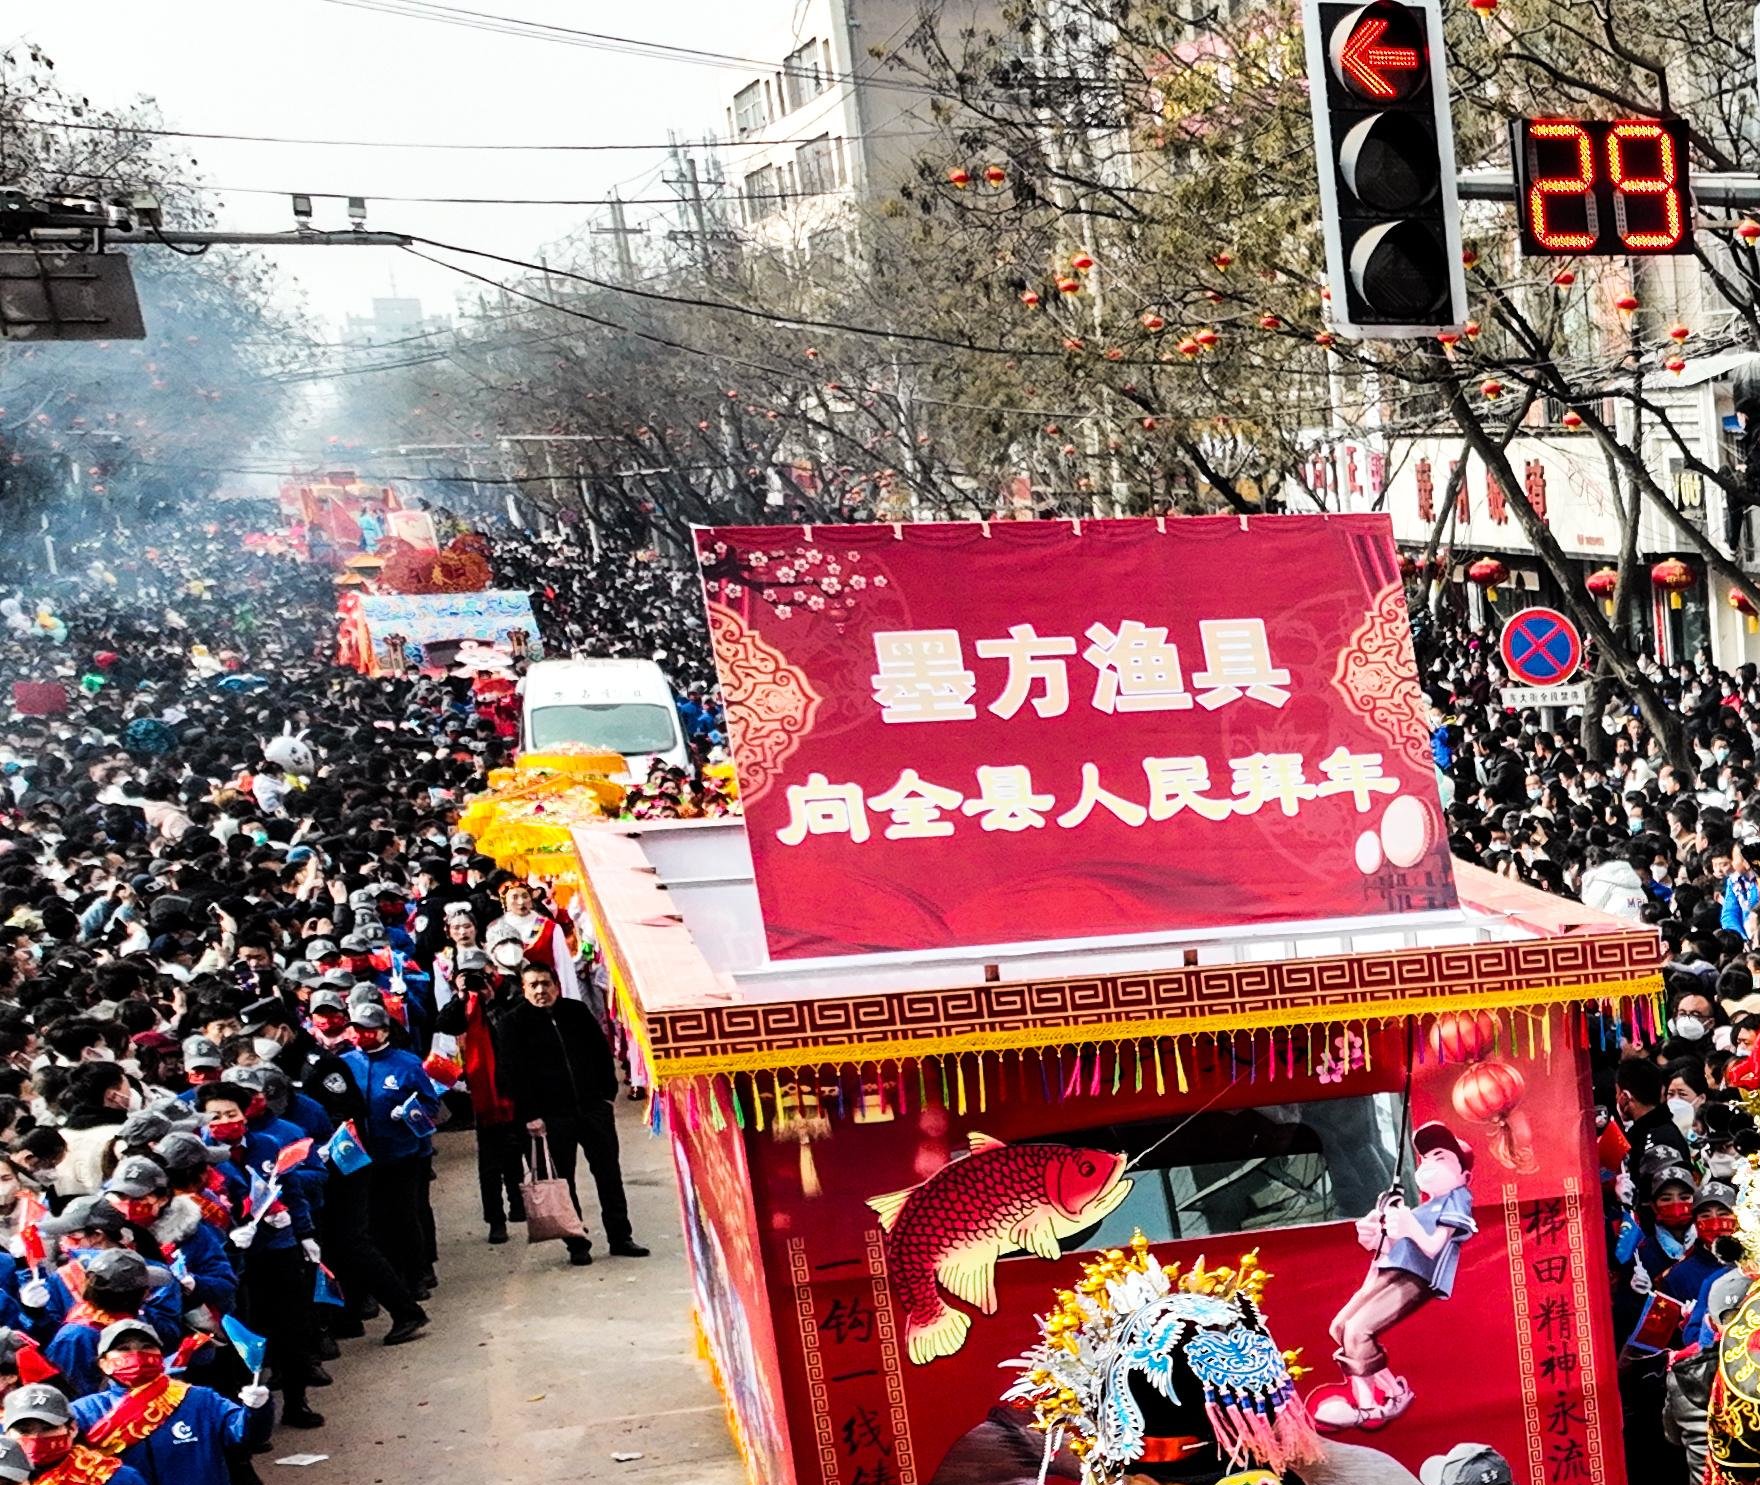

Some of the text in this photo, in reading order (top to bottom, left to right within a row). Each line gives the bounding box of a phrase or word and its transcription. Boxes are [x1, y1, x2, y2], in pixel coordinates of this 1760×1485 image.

[1528, 119, 1683, 249] 29
[871, 618, 1292, 723] 墨方渔具
[776, 746, 1399, 847] 向全县人民拜年
